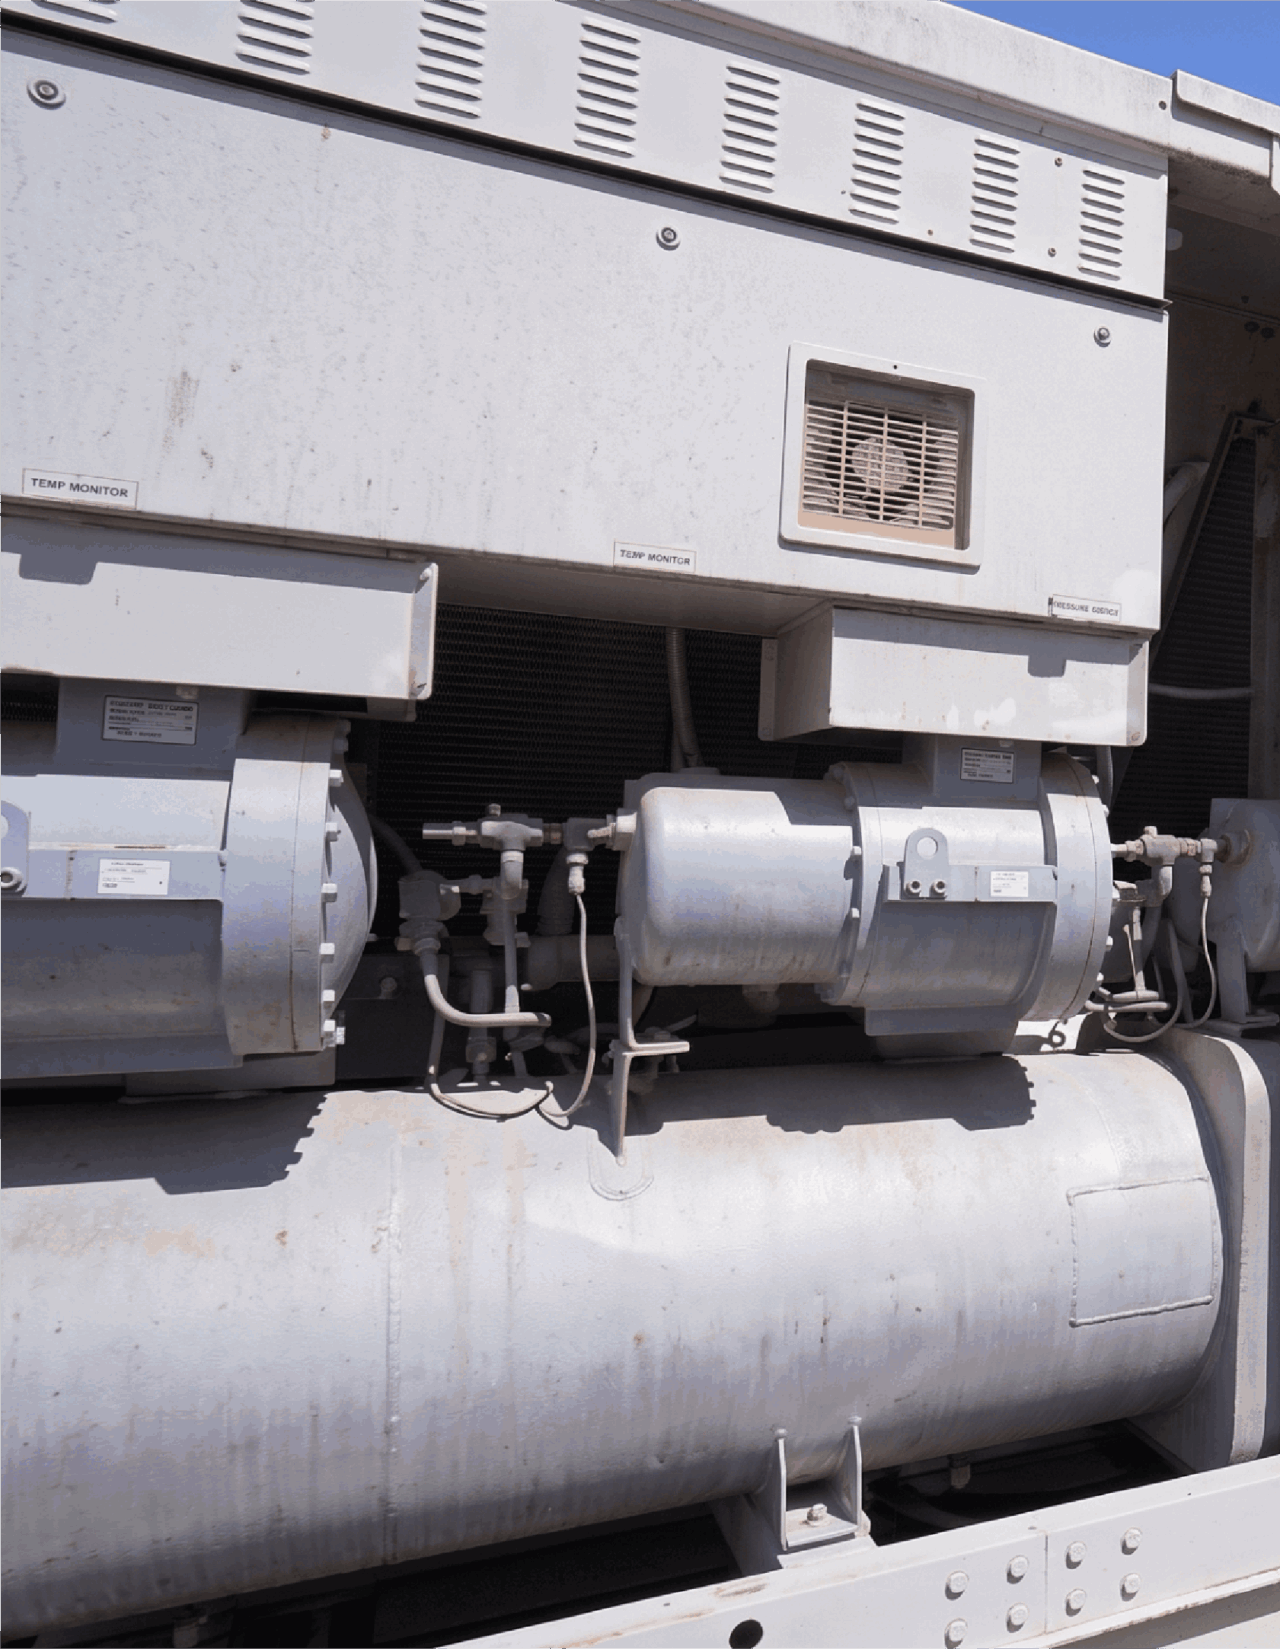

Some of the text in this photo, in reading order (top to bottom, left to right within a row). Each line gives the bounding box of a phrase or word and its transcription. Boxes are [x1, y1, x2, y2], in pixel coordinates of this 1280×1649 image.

[30, 477, 128, 498] TEMP MONITOR
[620, 549, 691, 566] TEMP MONITOR
